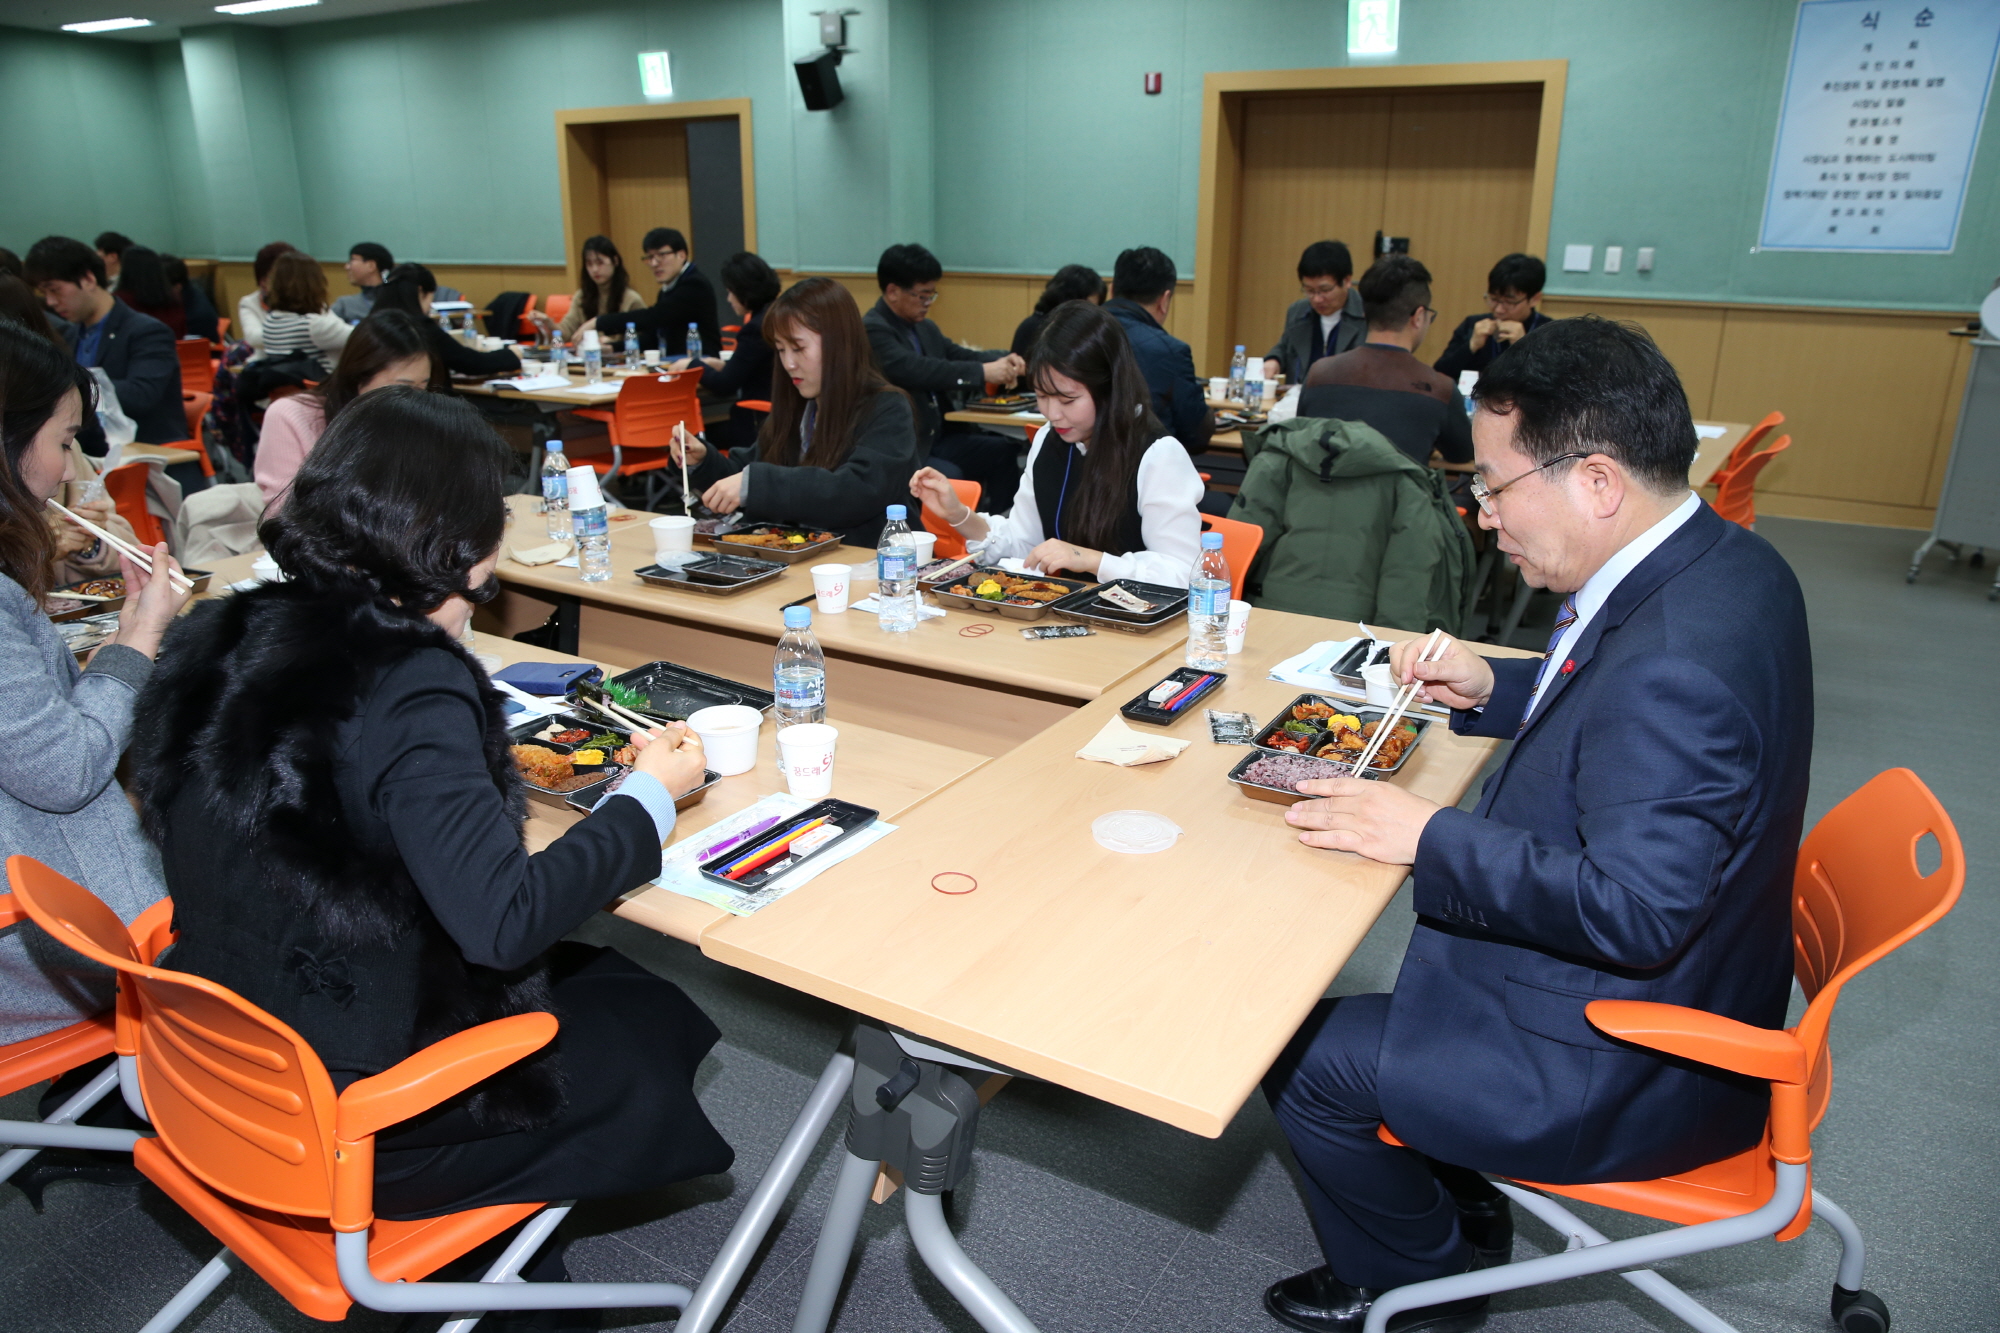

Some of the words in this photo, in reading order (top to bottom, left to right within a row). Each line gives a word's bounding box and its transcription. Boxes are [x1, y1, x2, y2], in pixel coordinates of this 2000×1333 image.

[1860, 10, 1881, 31] 식
[1914, 7, 1935, 28] 순
[1225, 628, 1240, 637] 드래
